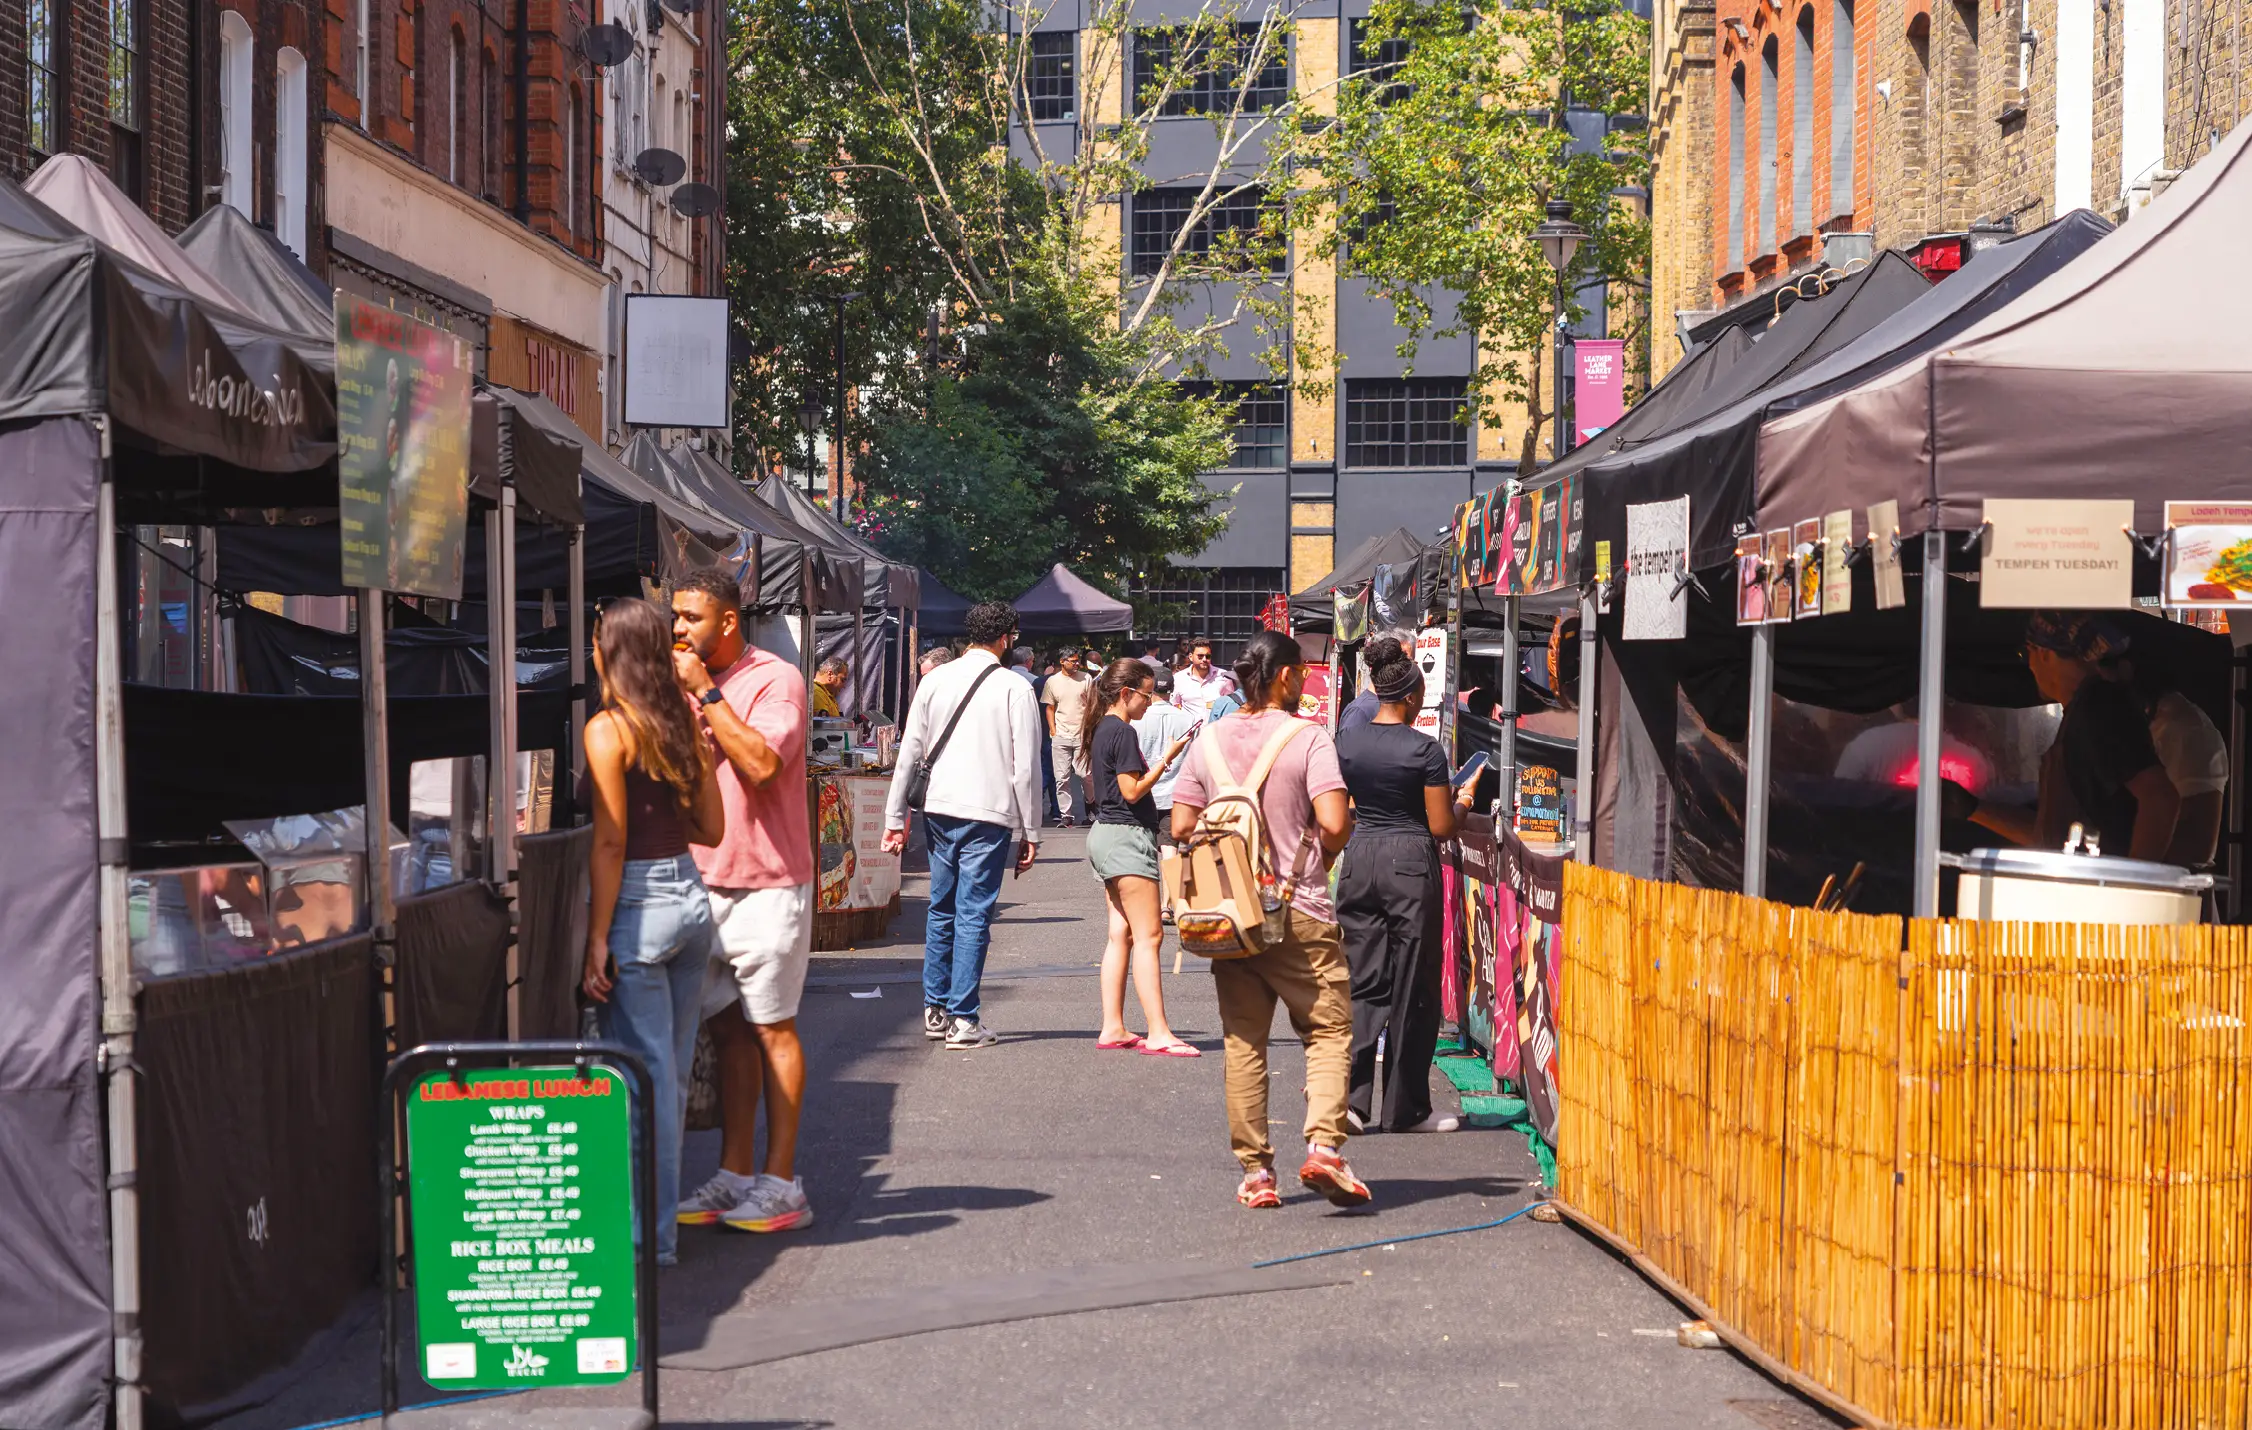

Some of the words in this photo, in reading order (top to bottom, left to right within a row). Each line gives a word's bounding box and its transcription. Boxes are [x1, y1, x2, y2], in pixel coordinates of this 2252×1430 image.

[1630, 545, 1642, 577] the
[1645, 540, 1673, 584] tempeh
[1996, 559, 2050, 570] TEMPEH
[2055, 559, 2119, 570] TUESDAY!
[1523, 765, 1557, 781] SUPPORT
[1535, 779, 1546, 788] US
[1533, 795, 1541, 806] @
[420, 1081, 529, 1101] LEBANESE
[533, 1078, 611, 1098] LUNCH
[489, 1105, 545, 1120] WRAPS
[470, 1124, 501, 1135] Lamb
[501, 1123, 531, 1137] Wrap
[465, 1146, 508, 1158] Chicken
[509, 1144, 540, 1157] Wrap
[459, 1167, 516, 1179] Shawarma
[516, 1165, 546, 1179] Wrap
[465, 1188, 512, 1200] Halloumi
[513, 1188, 543, 1201] Wrap
[463, 1210, 494, 1223] Large
[516, 1209, 546, 1223] Wrap
[451, 1241, 493, 1257] RICE
[495, 1240, 531, 1256] BOX
[534, 1237, 595, 1254] MEALS
[477, 1260, 505, 1272] RICE
[506, 1259, 532, 1272] BOX
[447, 1290, 513, 1302] SHAWARMA
[514, 1288, 541, 1300] RICE
[542, 1287, 568, 1299] BOX
[461, 1316, 500, 1330] LARGE
[501, 1316, 529, 1328] RICE
[530, 1315, 556, 1328] BOX
